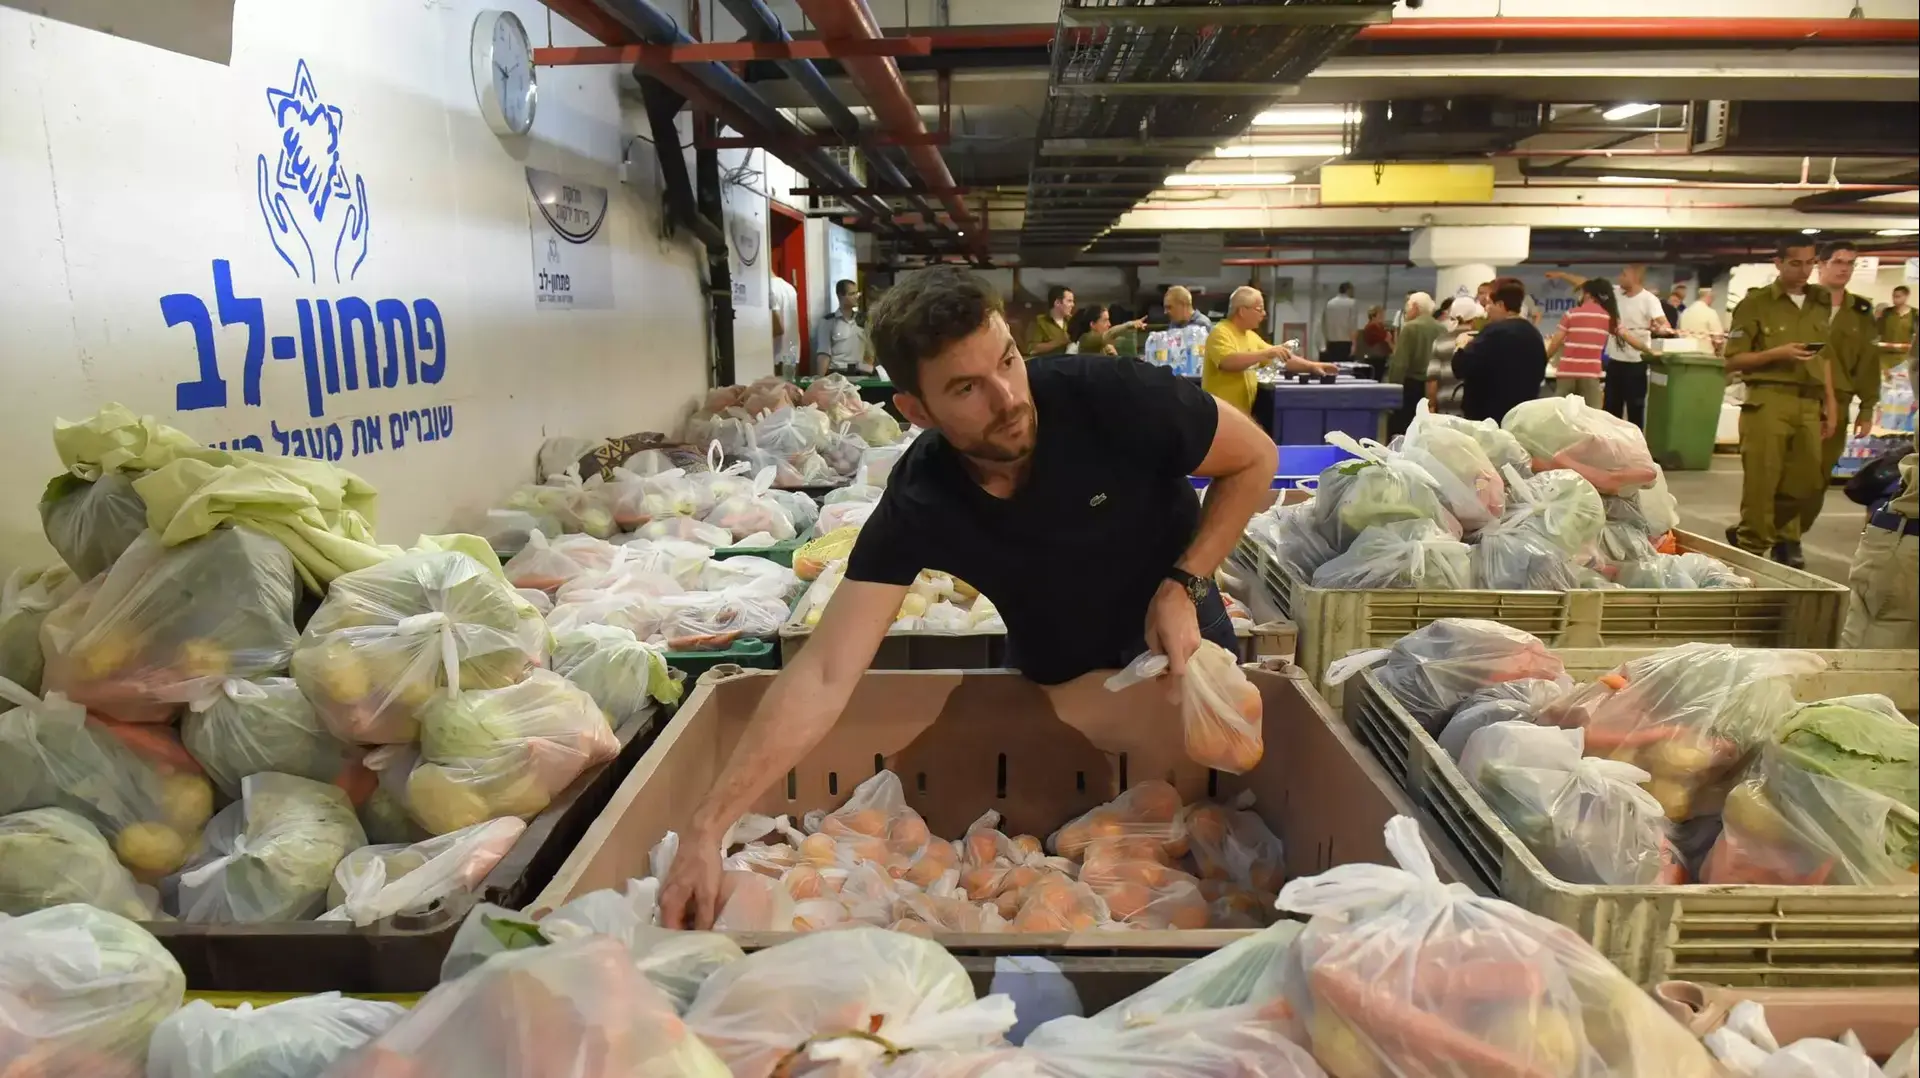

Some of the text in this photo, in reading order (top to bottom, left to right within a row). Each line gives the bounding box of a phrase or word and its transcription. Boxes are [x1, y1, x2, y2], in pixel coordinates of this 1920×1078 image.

[538, 267, 571, 293] פתחון-לב
[159, 258, 446, 418] פתחון-לב
[270, 419, 344, 462] מעגל
[352, 415, 384, 458] את
[388, 405, 453, 450] שוברים
